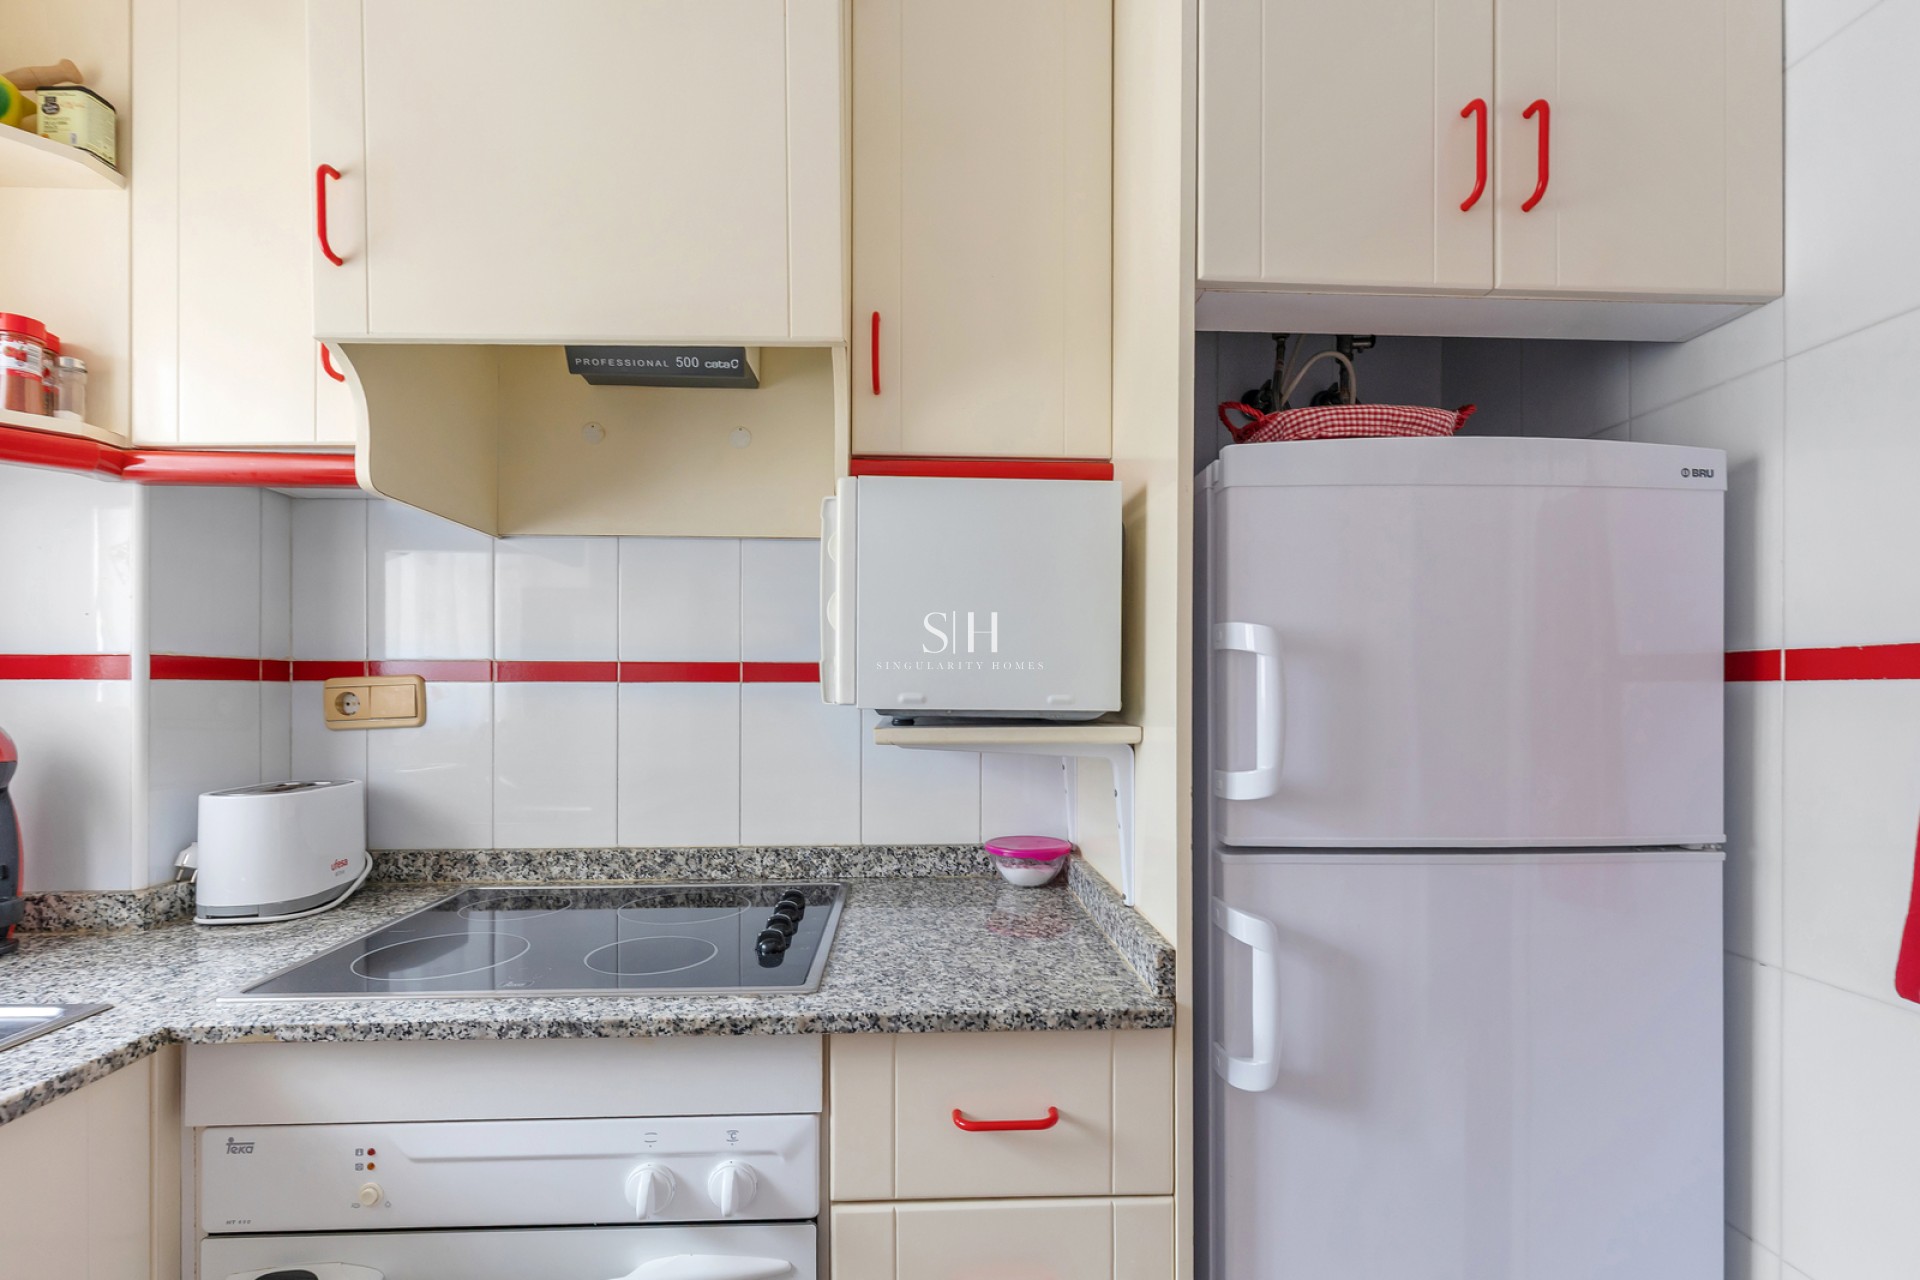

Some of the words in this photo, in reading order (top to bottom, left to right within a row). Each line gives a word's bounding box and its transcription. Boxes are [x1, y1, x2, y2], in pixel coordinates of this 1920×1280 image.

[575, 358, 670, 368] PROFESSIONAL
[675, 356, 700, 368] 500
[1691, 468, 1715, 478] BRU
